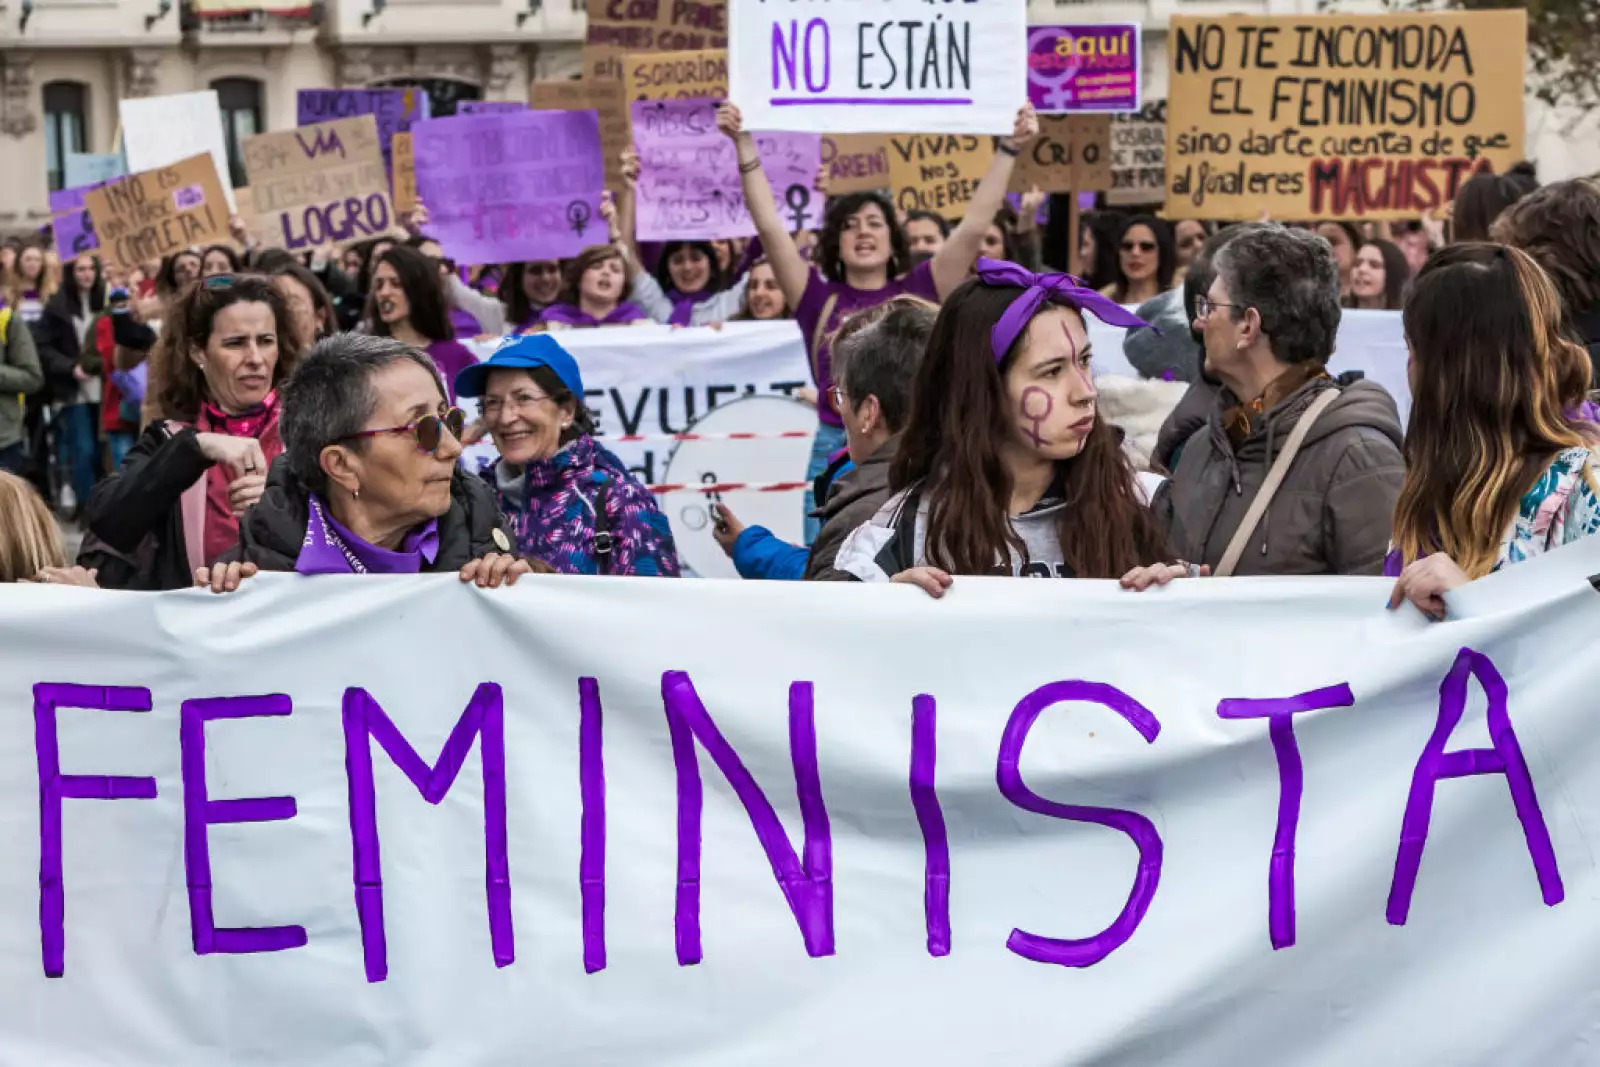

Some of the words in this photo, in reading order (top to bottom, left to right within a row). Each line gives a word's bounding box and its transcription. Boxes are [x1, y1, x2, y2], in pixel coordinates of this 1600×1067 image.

[771, 17, 831, 93] NO
[856, 13, 971, 91] ESTÁN
[1055, 30, 1130, 66] aquí
[1175, 24, 1226, 74] NO
[1236, 26, 1280, 69] TE
[1288, 25, 1474, 76] INCOMODA
[1209, 77, 1254, 115] EL
[1270, 76, 1476, 128] FEMINISMO
[891, 134, 979, 162] VIVAS
[1176, 126, 1232, 156] sino
[1239, 127, 1315, 158] darte
[1320, 130, 1412, 157] cuenta
[1420, 131, 1455, 156] de
[1171, 162, 1192, 195] al
[1249, 171, 1305, 195] eres
[281, 192, 389, 249] LOGRO
[32, 646, 1565, 984] FEMINISTA
